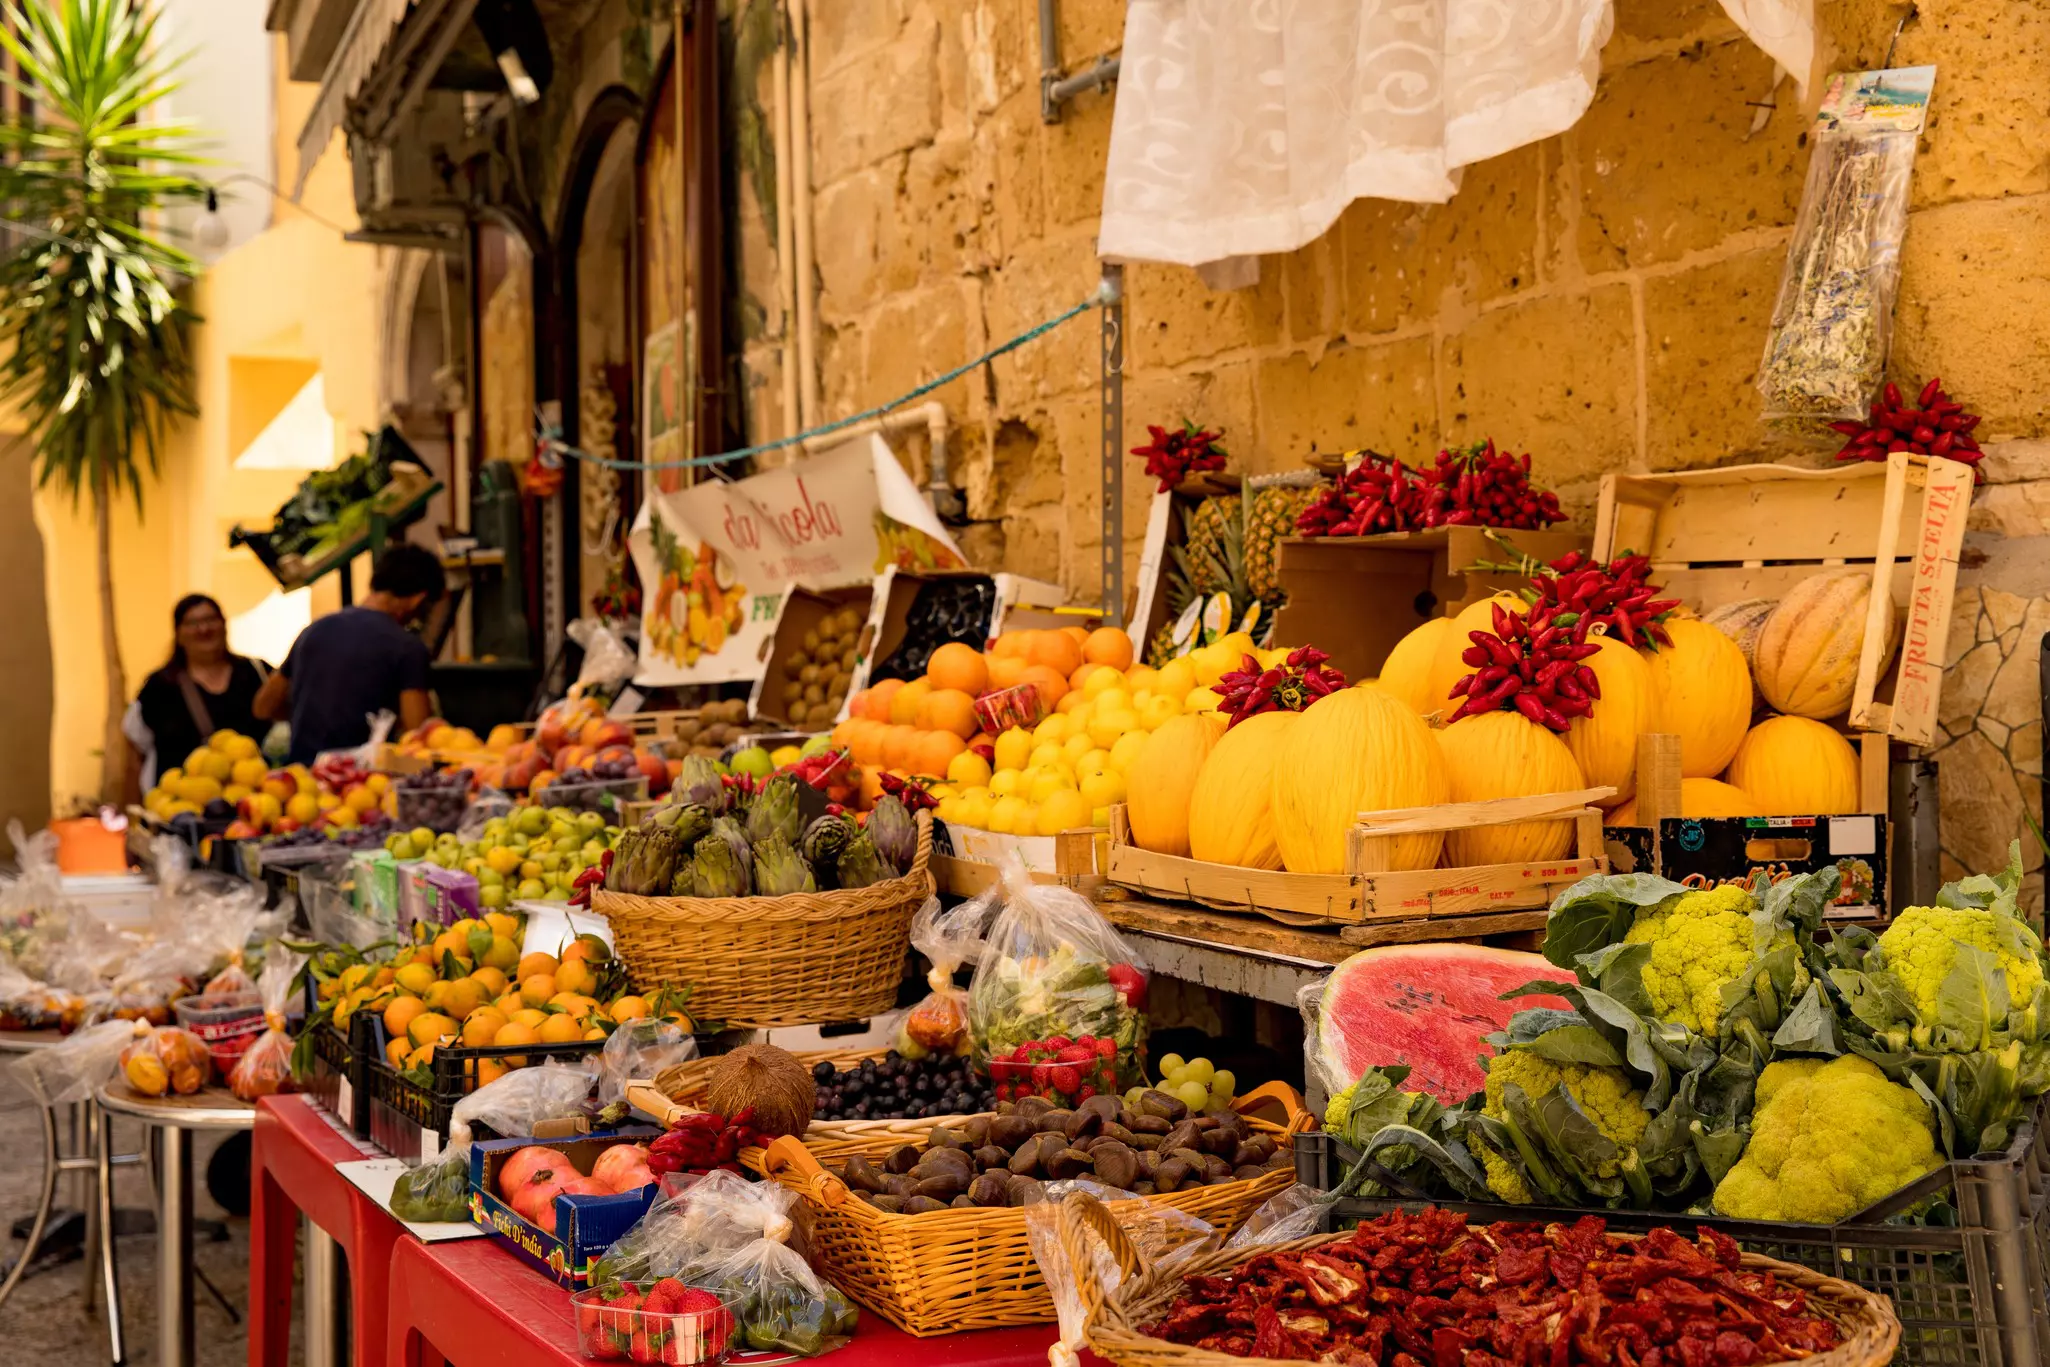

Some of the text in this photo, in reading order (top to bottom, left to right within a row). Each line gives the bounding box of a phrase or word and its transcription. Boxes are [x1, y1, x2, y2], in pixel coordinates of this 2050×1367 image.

[723, 502, 761, 550] da
[1904, 585, 1932, 684] FRUTTA
[1919, 485, 1957, 579] SCELTA
[492, 1210, 543, 1260] Fichi D'india
